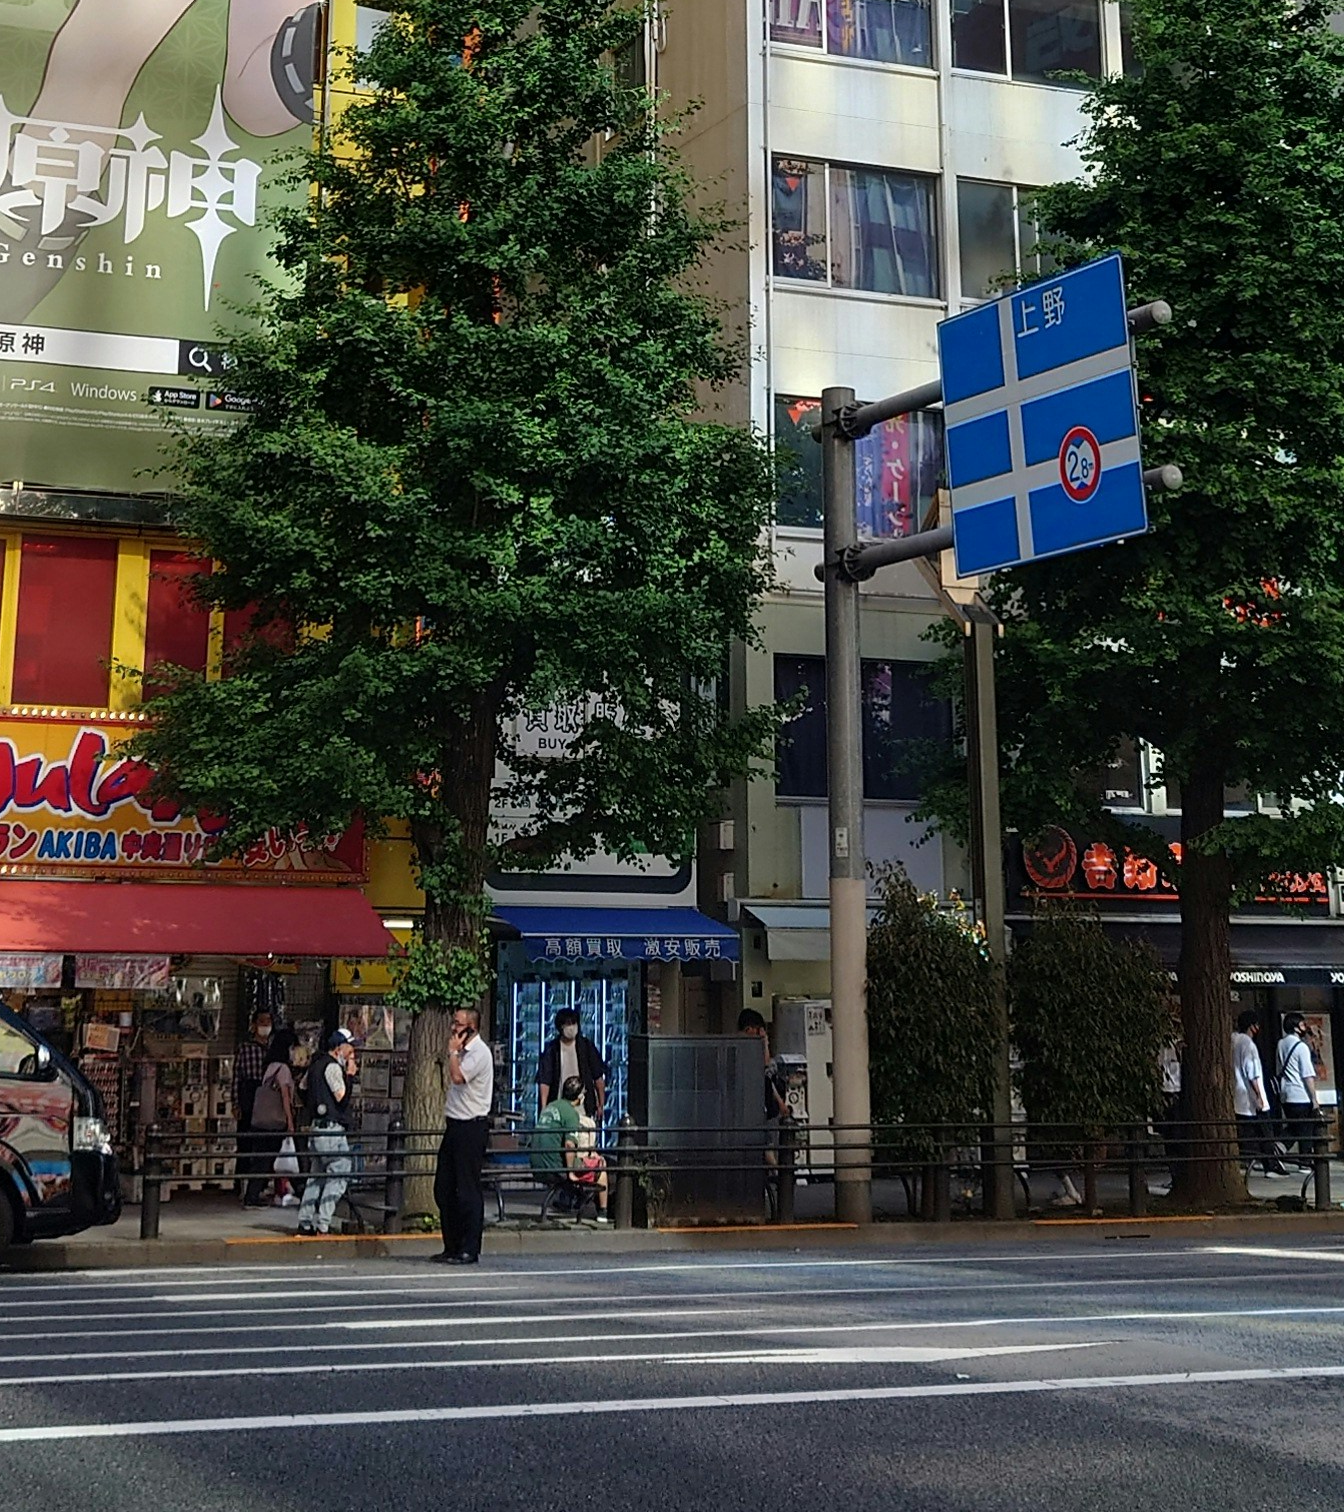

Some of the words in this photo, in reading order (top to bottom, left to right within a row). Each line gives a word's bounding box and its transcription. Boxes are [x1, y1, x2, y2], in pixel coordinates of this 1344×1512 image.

[1017, 286, 1065, 339] 上野
[10, 378, 57, 394] PS4
[71, 381, 138, 402] Windows
[164, 390, 178, 400] App
[179, 392, 197, 401] Store
[538, 738, 567, 750] BUY
[35, 826, 118, 863] AKIBA
[121, 828, 223, 867] 中央通り
[545, 939, 623, 957] 高額買取
[644, 939, 722, 958] 激安販売
